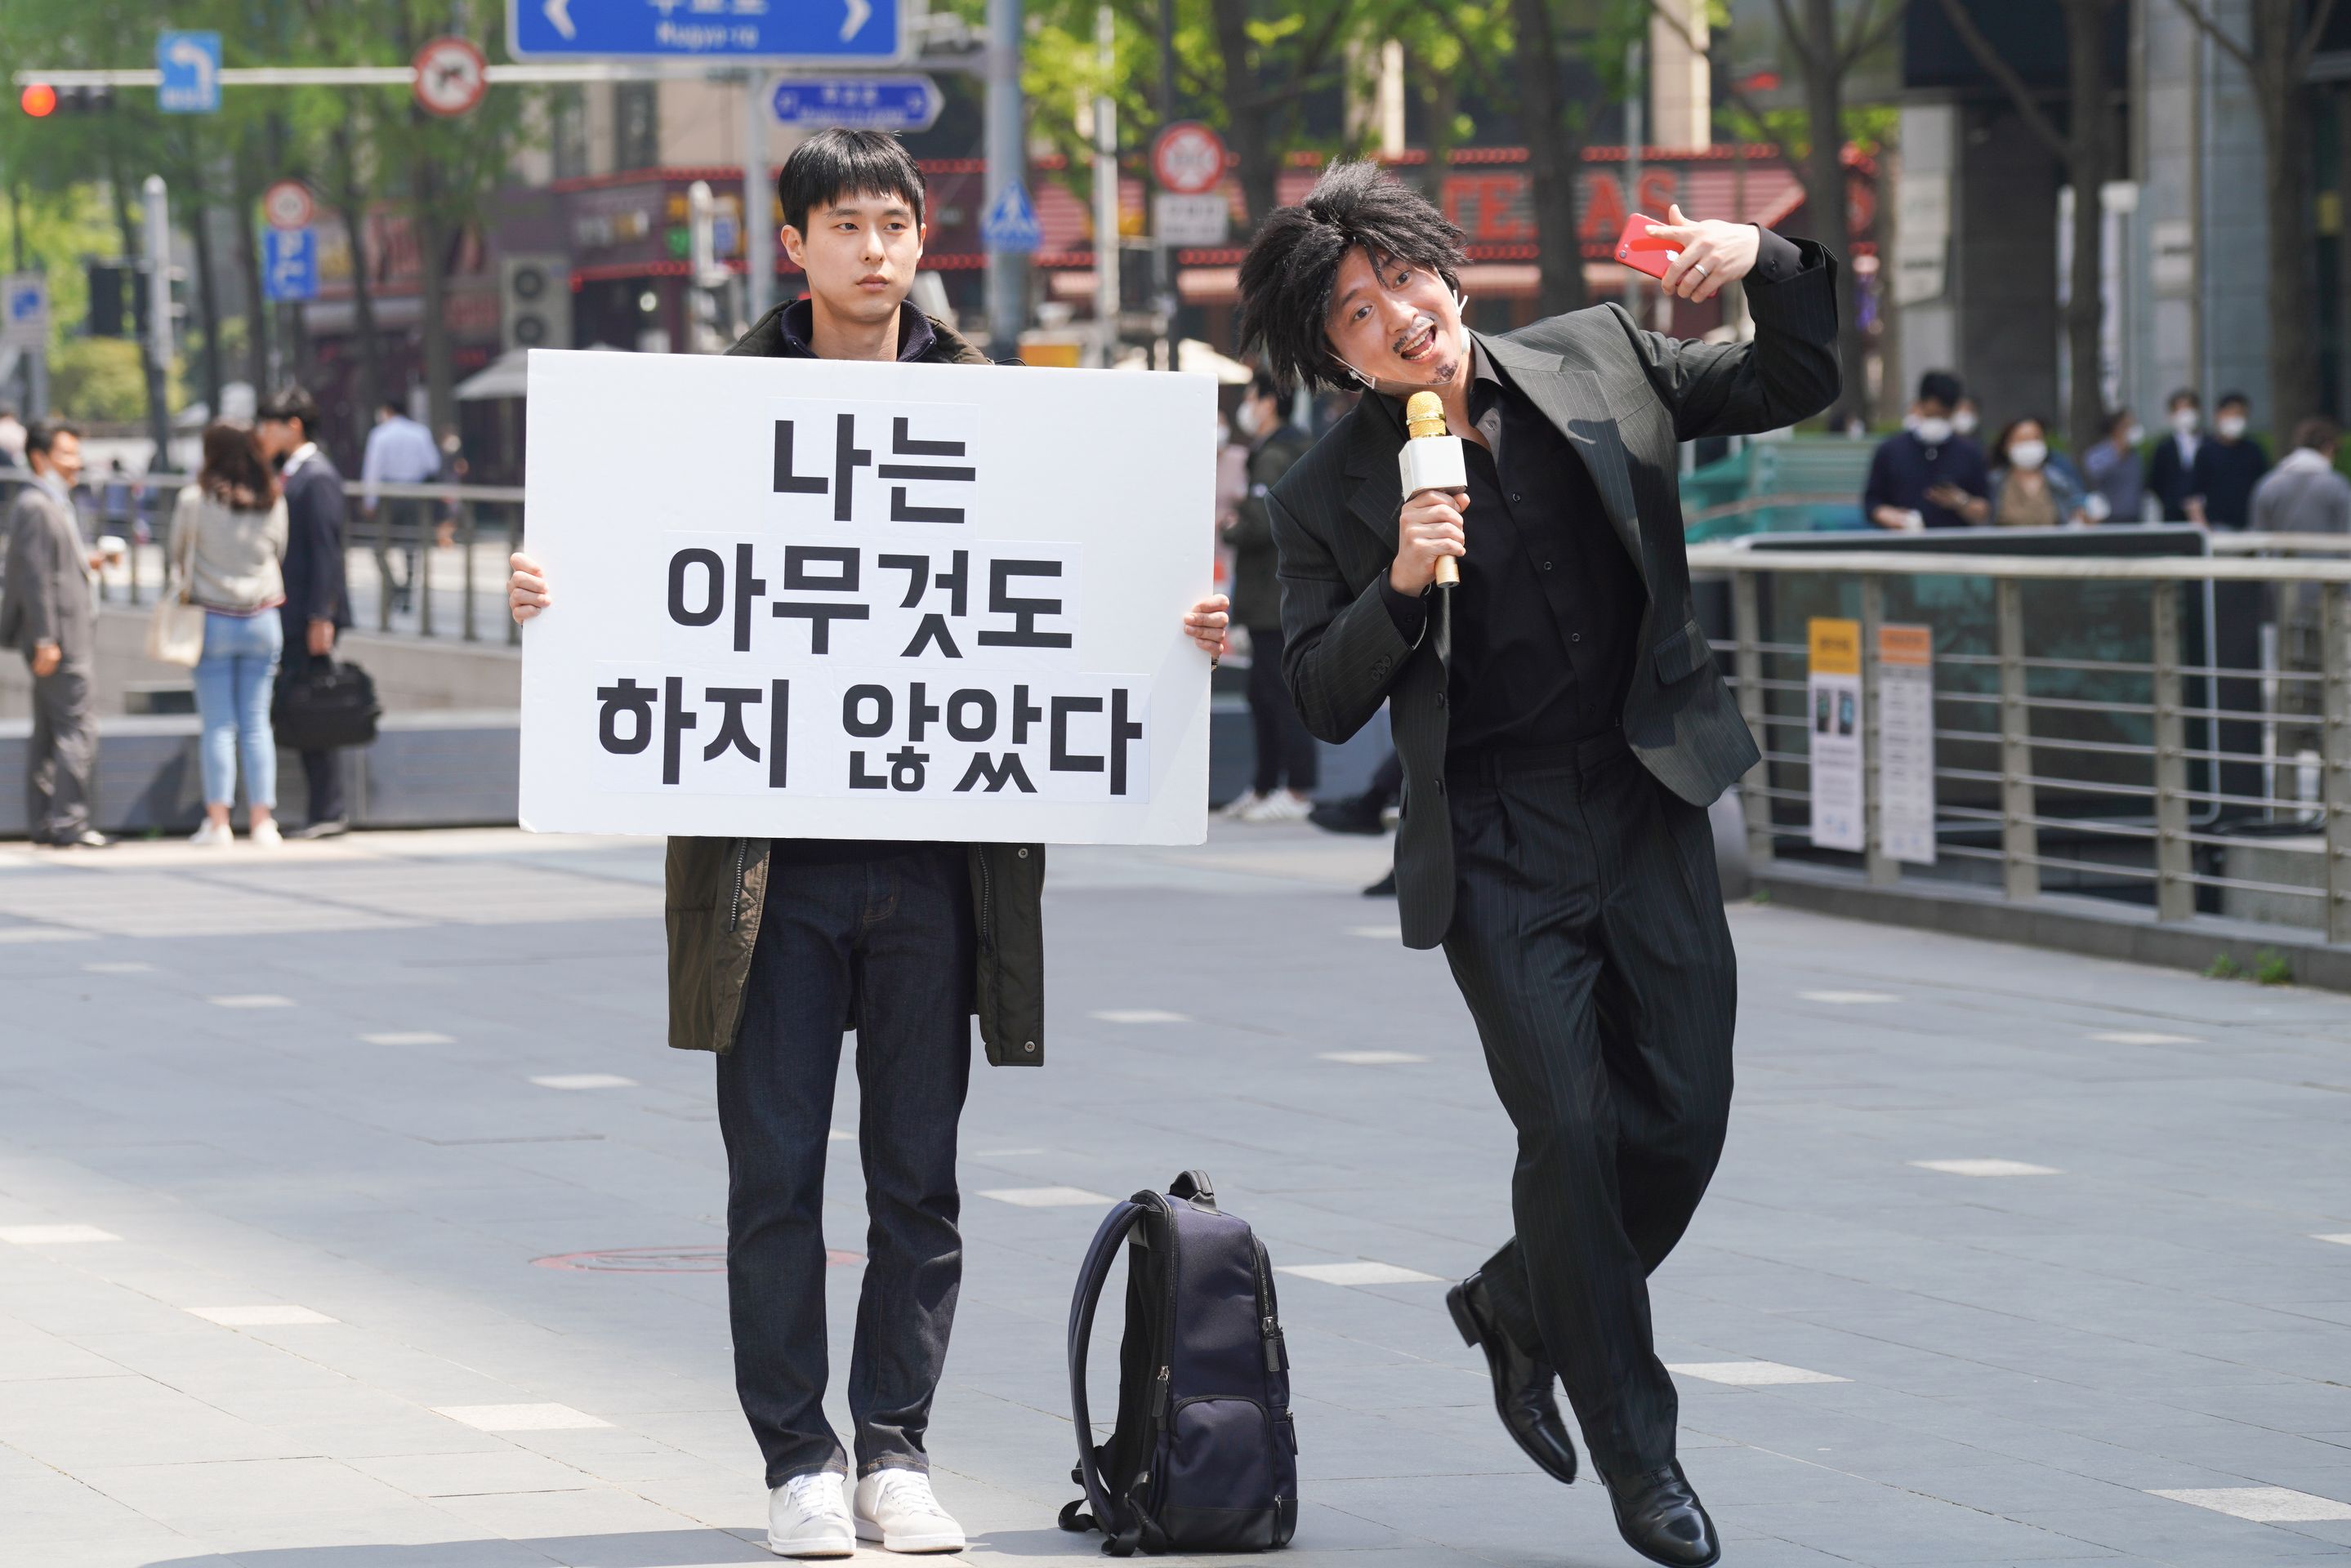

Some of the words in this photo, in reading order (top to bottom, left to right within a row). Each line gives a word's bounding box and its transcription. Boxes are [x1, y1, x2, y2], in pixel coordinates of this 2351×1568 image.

[1441, 166, 1677, 242] TEAS
[773, 414, 976, 523] 나는
[667, 543, 1073, 659] 아무것도
[596, 676, 789, 788] 하지
[842, 682, 1143, 795] 않았다
